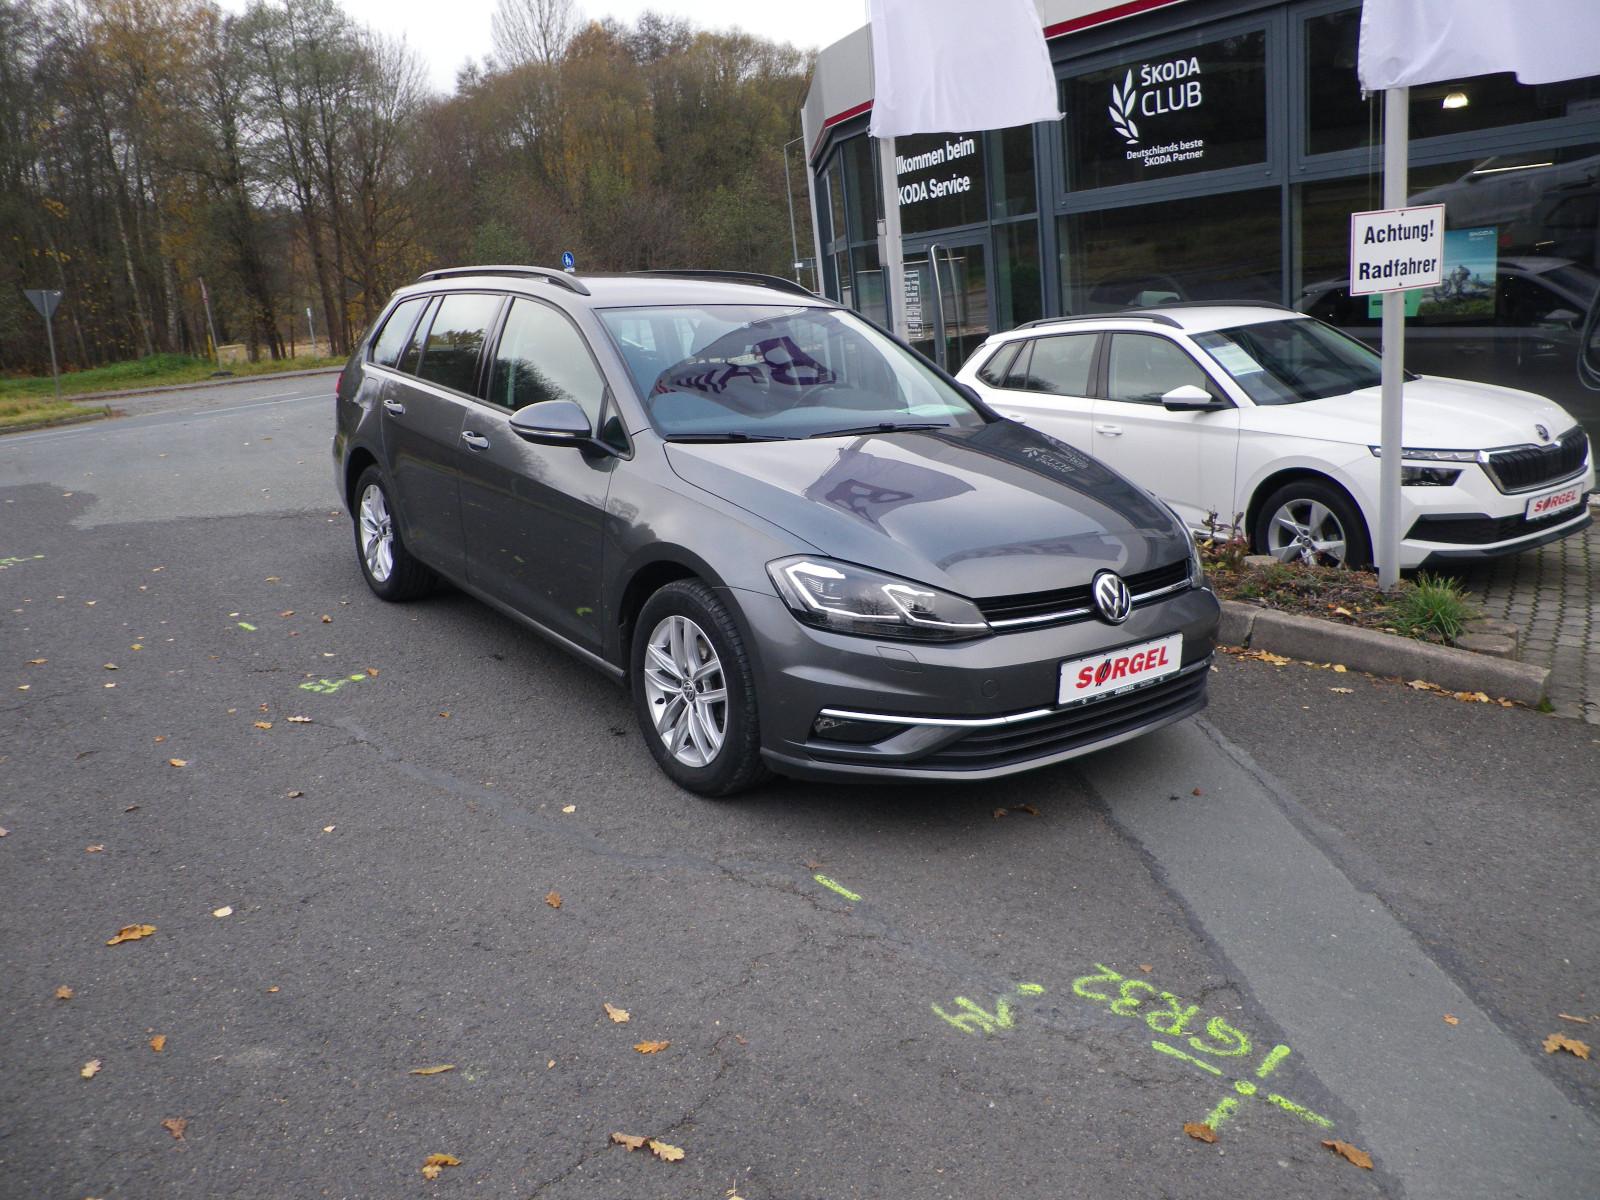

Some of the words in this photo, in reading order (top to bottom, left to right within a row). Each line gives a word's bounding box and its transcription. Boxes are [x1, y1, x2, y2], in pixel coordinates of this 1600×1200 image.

[1140, 57, 1201, 87] ŠKODA
[1141, 81, 1202, 117] CLUB
[895, 148, 945, 175] llkommen
[945, 136, 975, 161] beim
[1126, 143, 1179, 160] Deutschlands
[1180, 139, 1204, 150] beste
[1173, 150, 1204, 162] Partner
[897, 181, 929, 206] KODA
[929, 173, 971, 199] Service
[1363, 219, 1434, 244] Achtung!
[1358, 257, 1437, 281] Radfahrer
